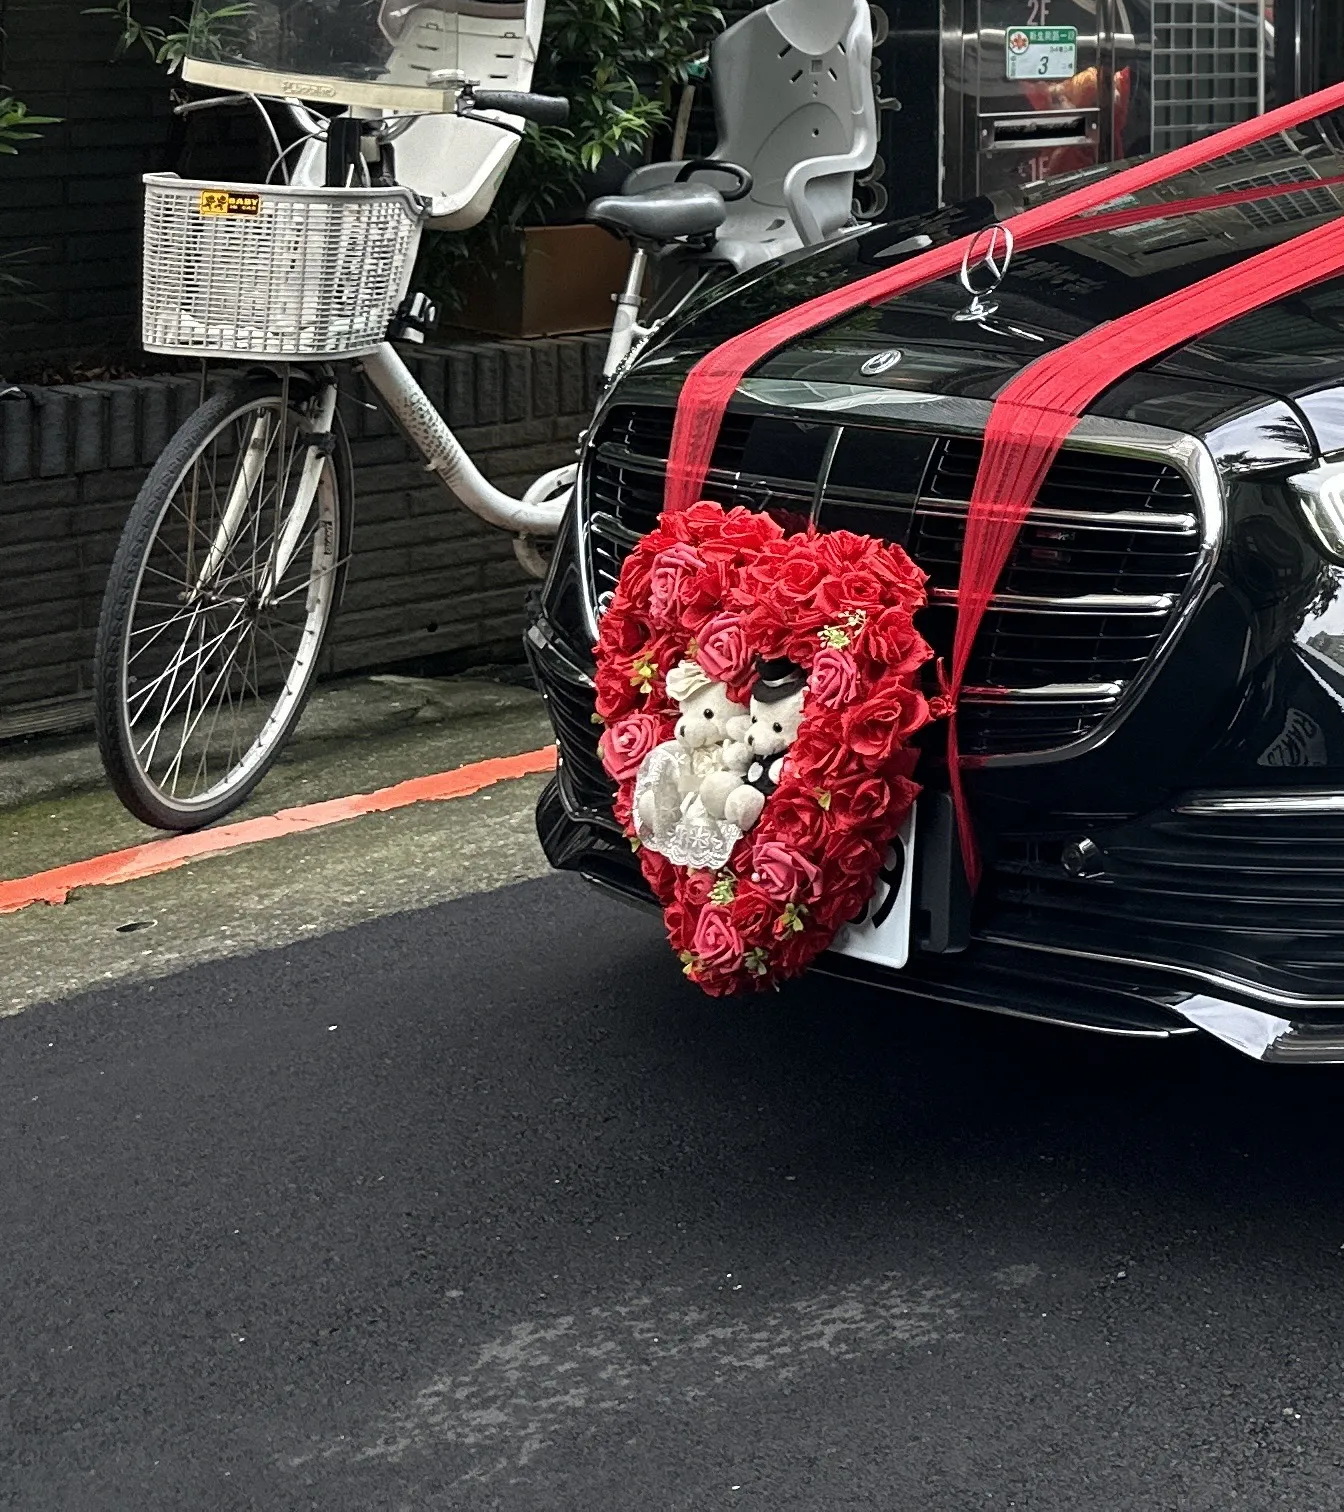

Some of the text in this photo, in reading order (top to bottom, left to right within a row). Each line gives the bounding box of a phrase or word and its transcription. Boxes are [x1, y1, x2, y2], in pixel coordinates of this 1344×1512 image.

[1038, 56, 1049, 75] 3
[1029, 156, 1050, 182] 1F
[228, 197, 259, 206] BABY
